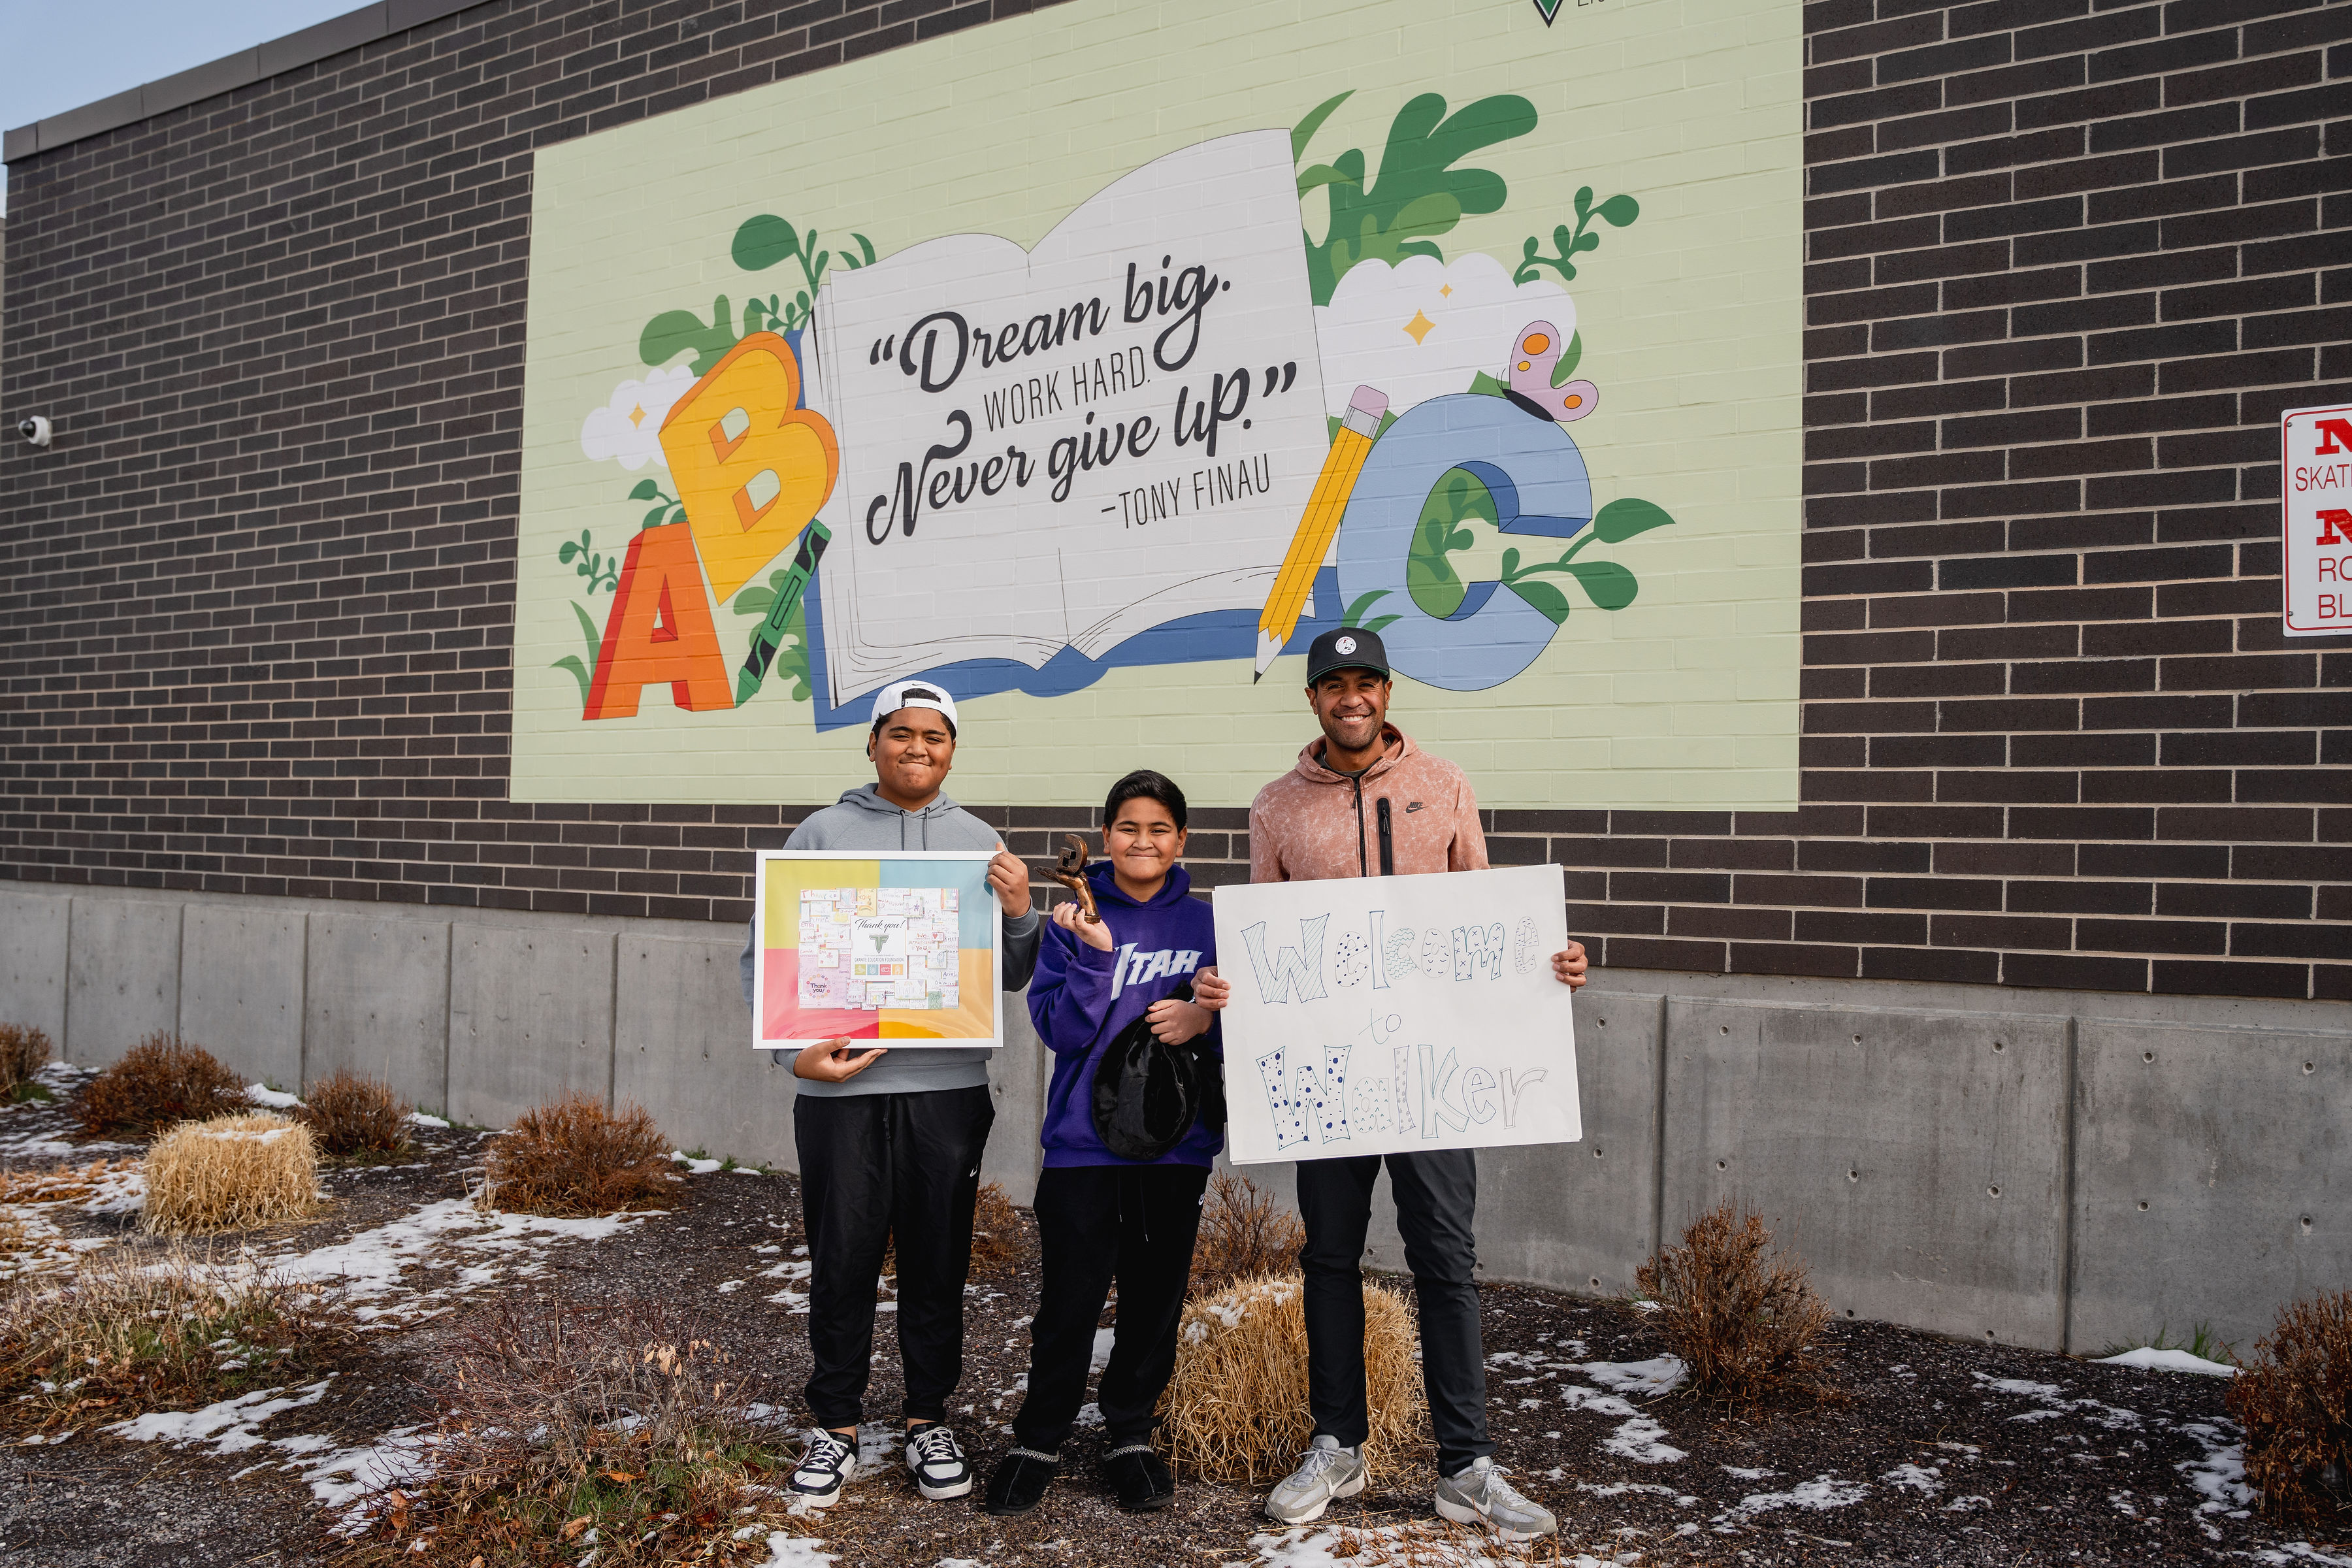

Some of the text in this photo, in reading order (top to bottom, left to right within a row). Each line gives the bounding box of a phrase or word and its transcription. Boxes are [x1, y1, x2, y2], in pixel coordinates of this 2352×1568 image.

[1123, 255, 1231, 372] big.
[983, 346, 1151, 432] WORK HARD.
[866, 409, 1035, 546] Never
[1047, 411, 1159, 503] give
[1192, 453, 1271, 511] FINAU
[2295, 463, 2352, 492] SKAT
[855, 918, 884, 930] Thank
[884, 919, 906, 933] you!
[1240, 910, 1540, 1004] Welcome
[1358, 1008, 1401, 1045] to
[1256, 1043, 1549, 1151] Walker
